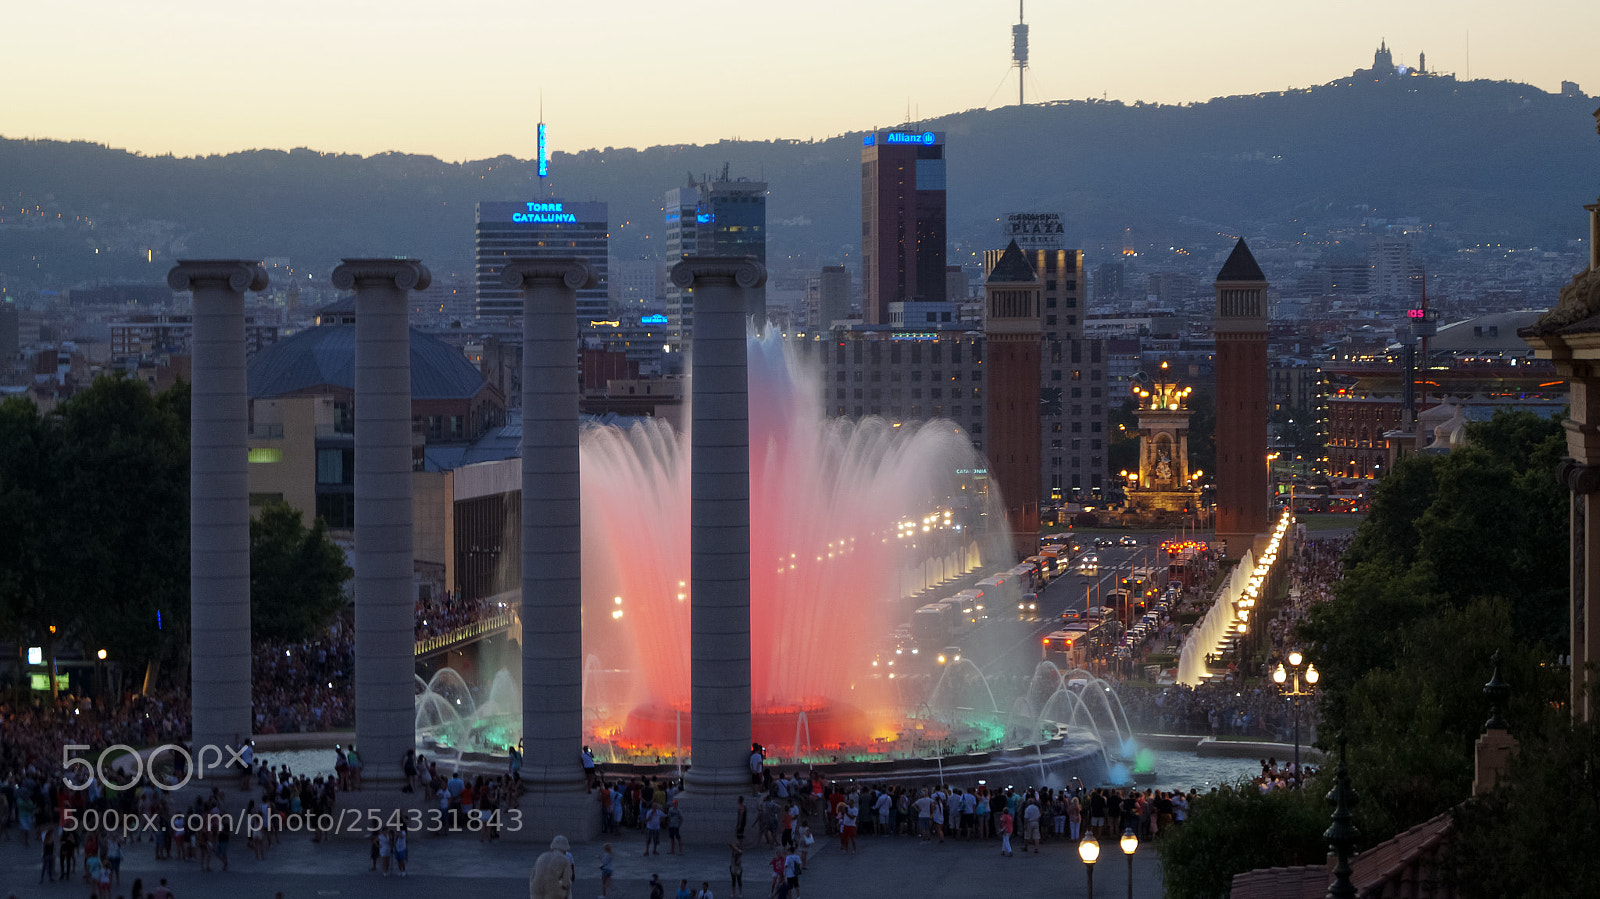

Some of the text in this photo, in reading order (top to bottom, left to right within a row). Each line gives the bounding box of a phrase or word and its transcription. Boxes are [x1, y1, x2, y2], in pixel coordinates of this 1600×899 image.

[887, 132, 922, 143] Allianz
[526, 202, 563, 212] TORRE
[512, 212, 577, 223] CATALUNYA
[1012, 223, 1065, 233] PLAZA
